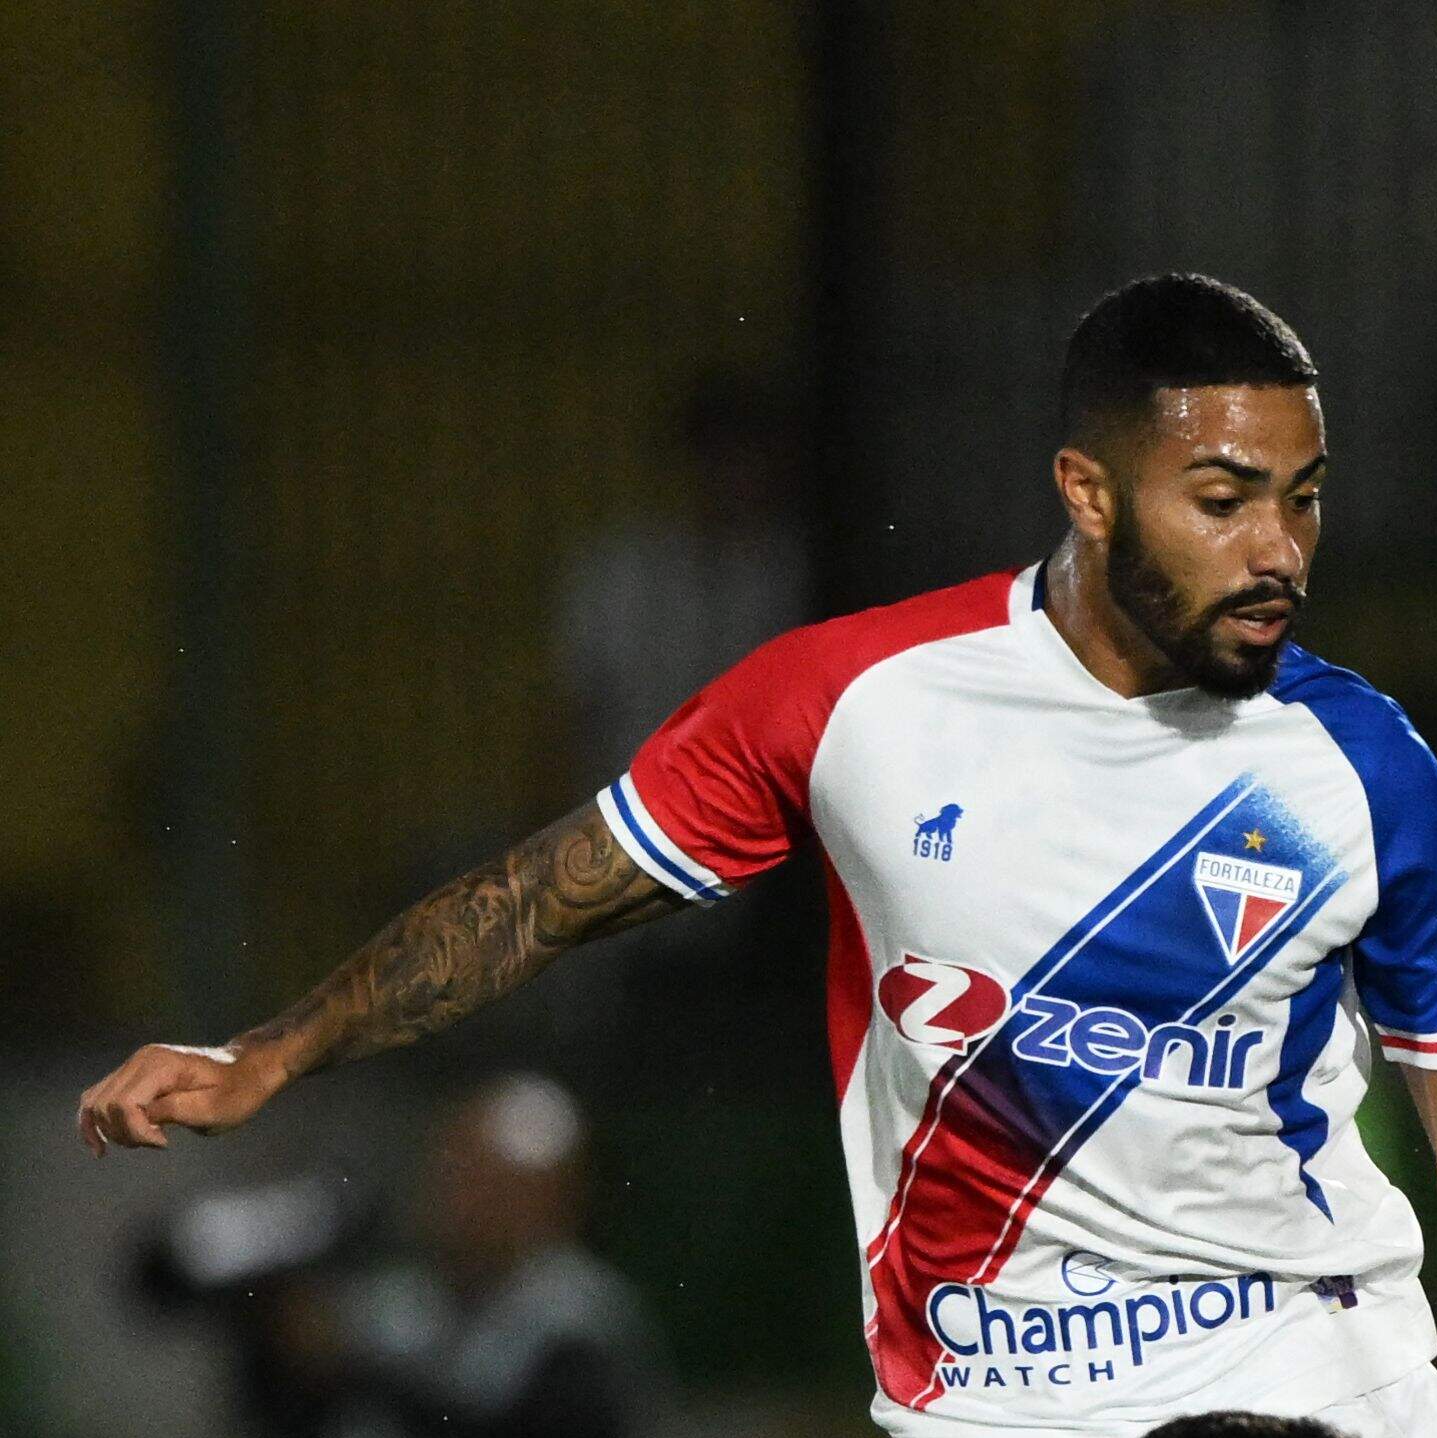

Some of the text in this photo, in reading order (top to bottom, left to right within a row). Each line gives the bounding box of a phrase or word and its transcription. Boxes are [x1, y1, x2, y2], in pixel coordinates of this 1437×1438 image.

[912, 837, 953, 862] 1918
[1199, 857, 1297, 895] FORTALEZA
[1013, 993, 1263, 1089] zenir
[931, 1271, 1275, 1367] Champion
[940, 1360, 1116, 1388] WATCH
